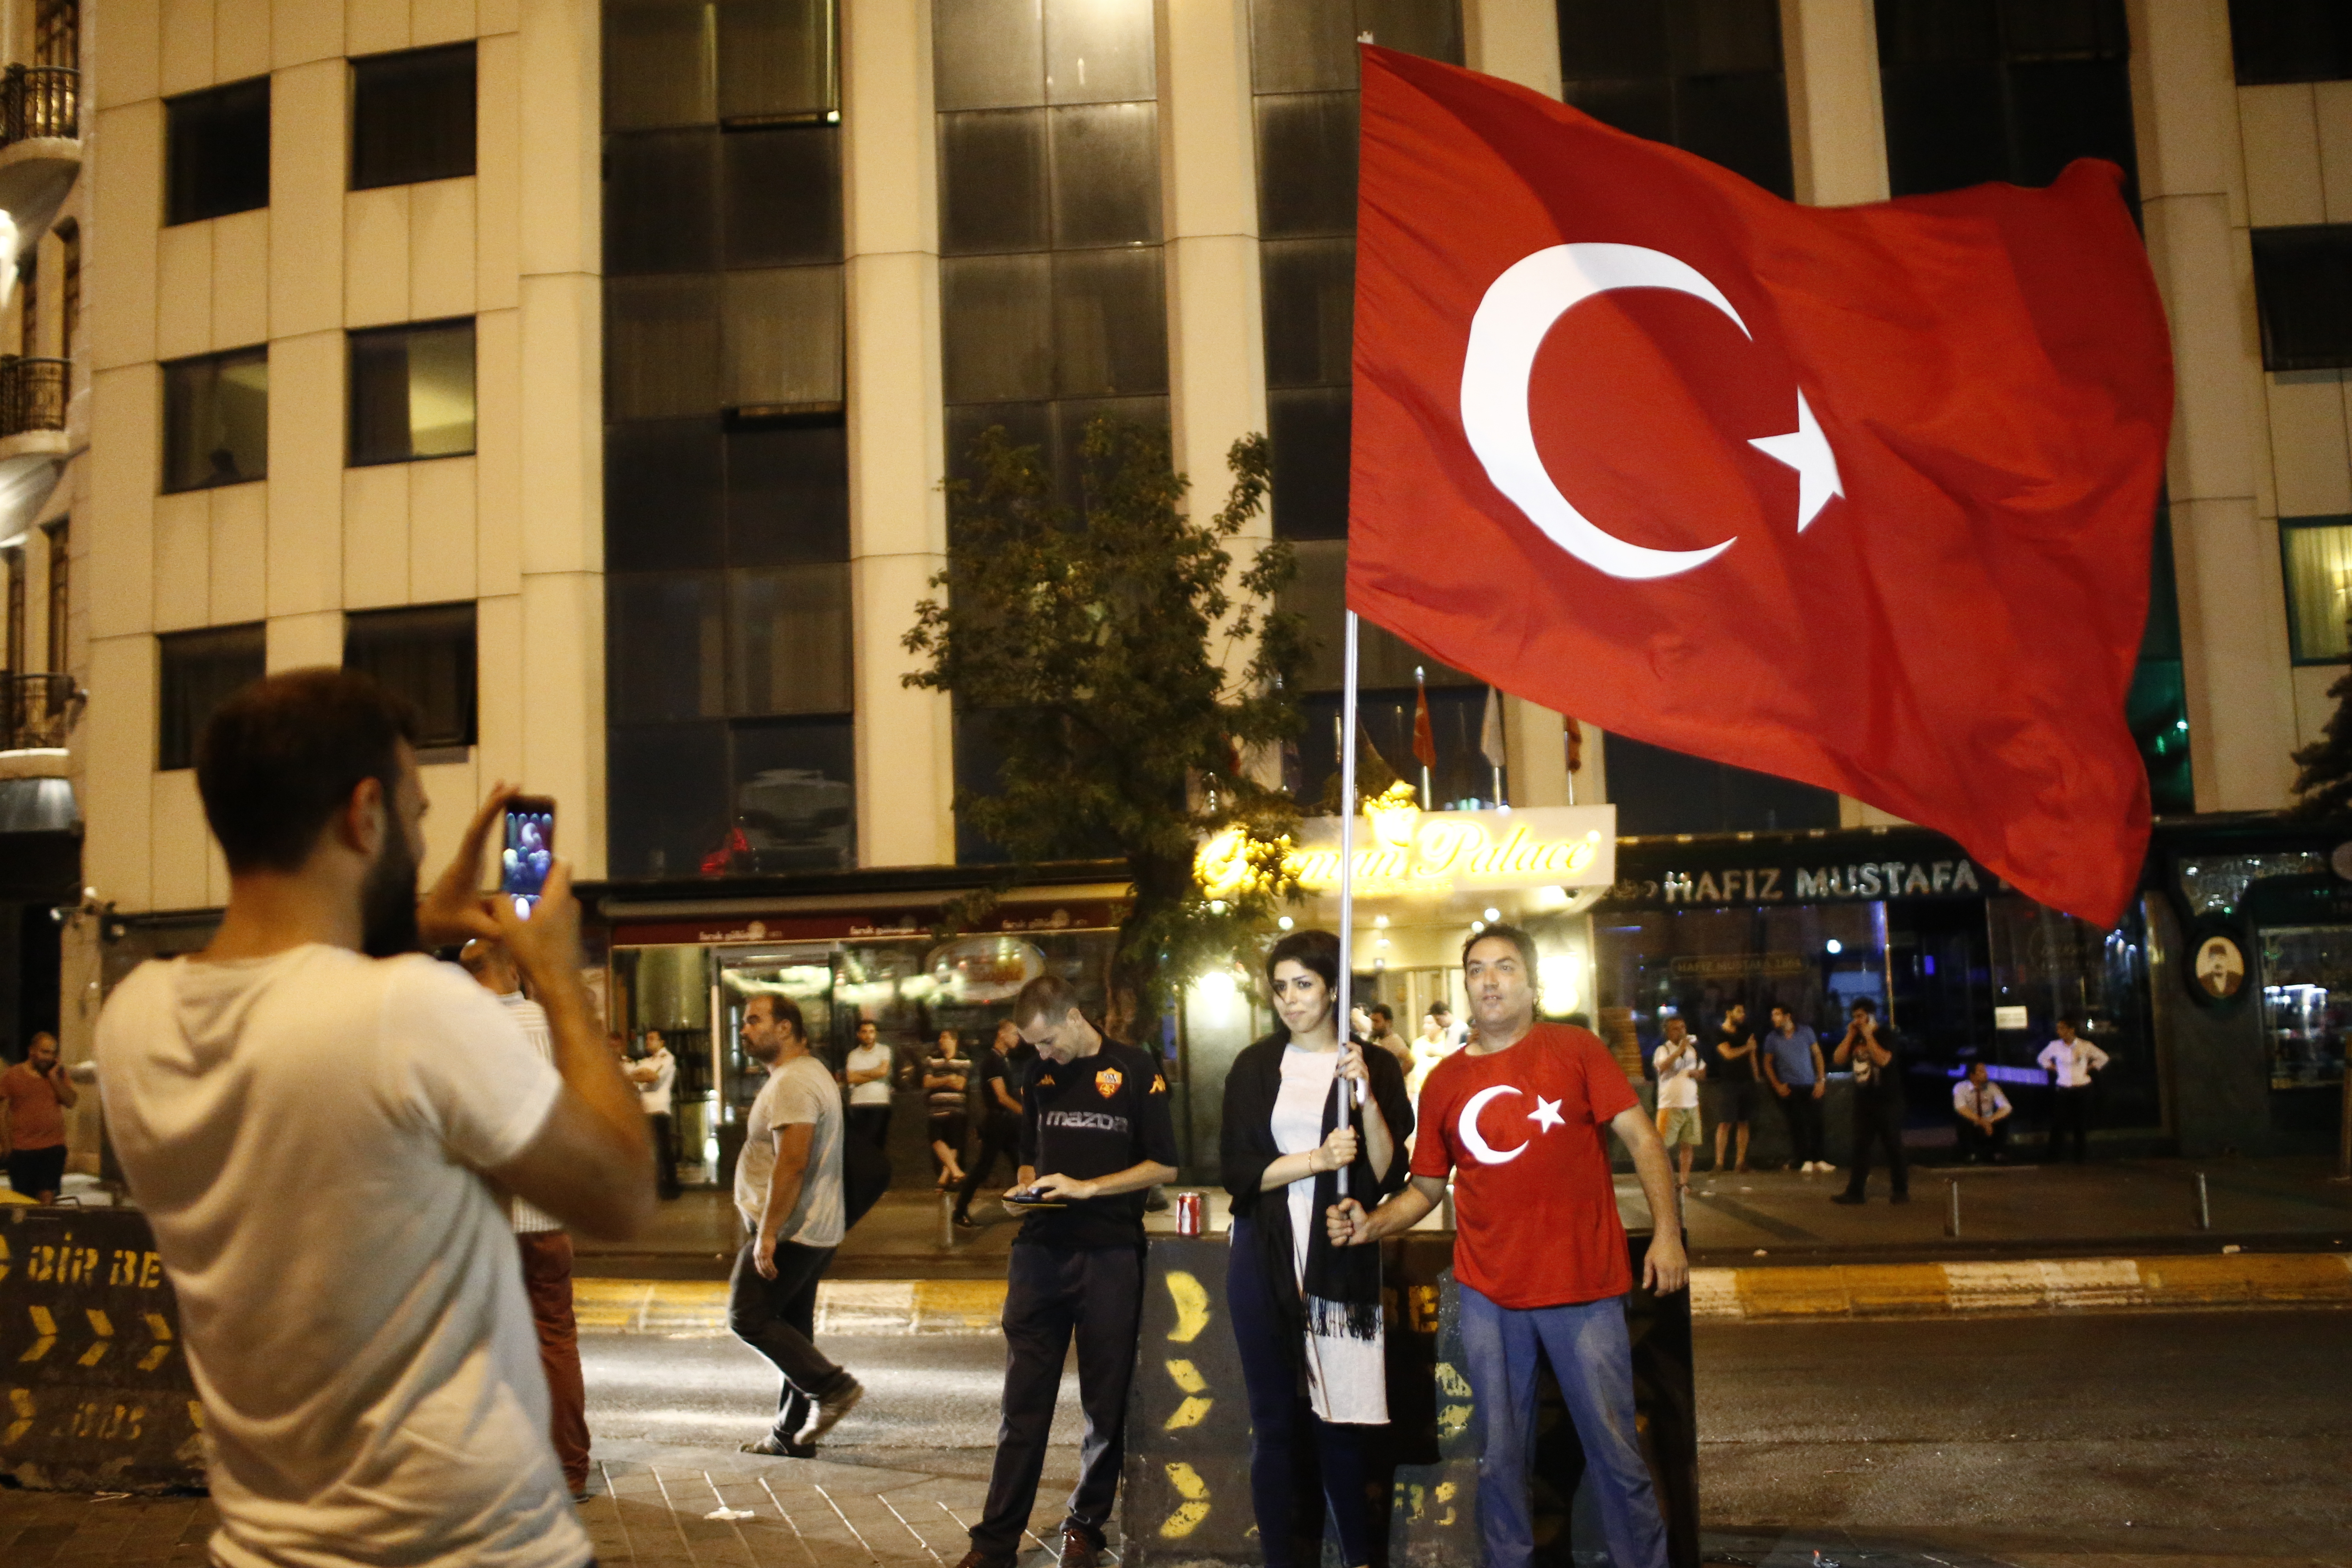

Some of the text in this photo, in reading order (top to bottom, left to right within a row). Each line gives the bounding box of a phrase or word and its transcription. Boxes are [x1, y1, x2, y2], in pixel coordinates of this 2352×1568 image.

[1413, 819, 1592, 877] Palace
[1664, 870, 1783, 903] HAFIZ
[1795, 859, 1979, 899] MUSTAFA
